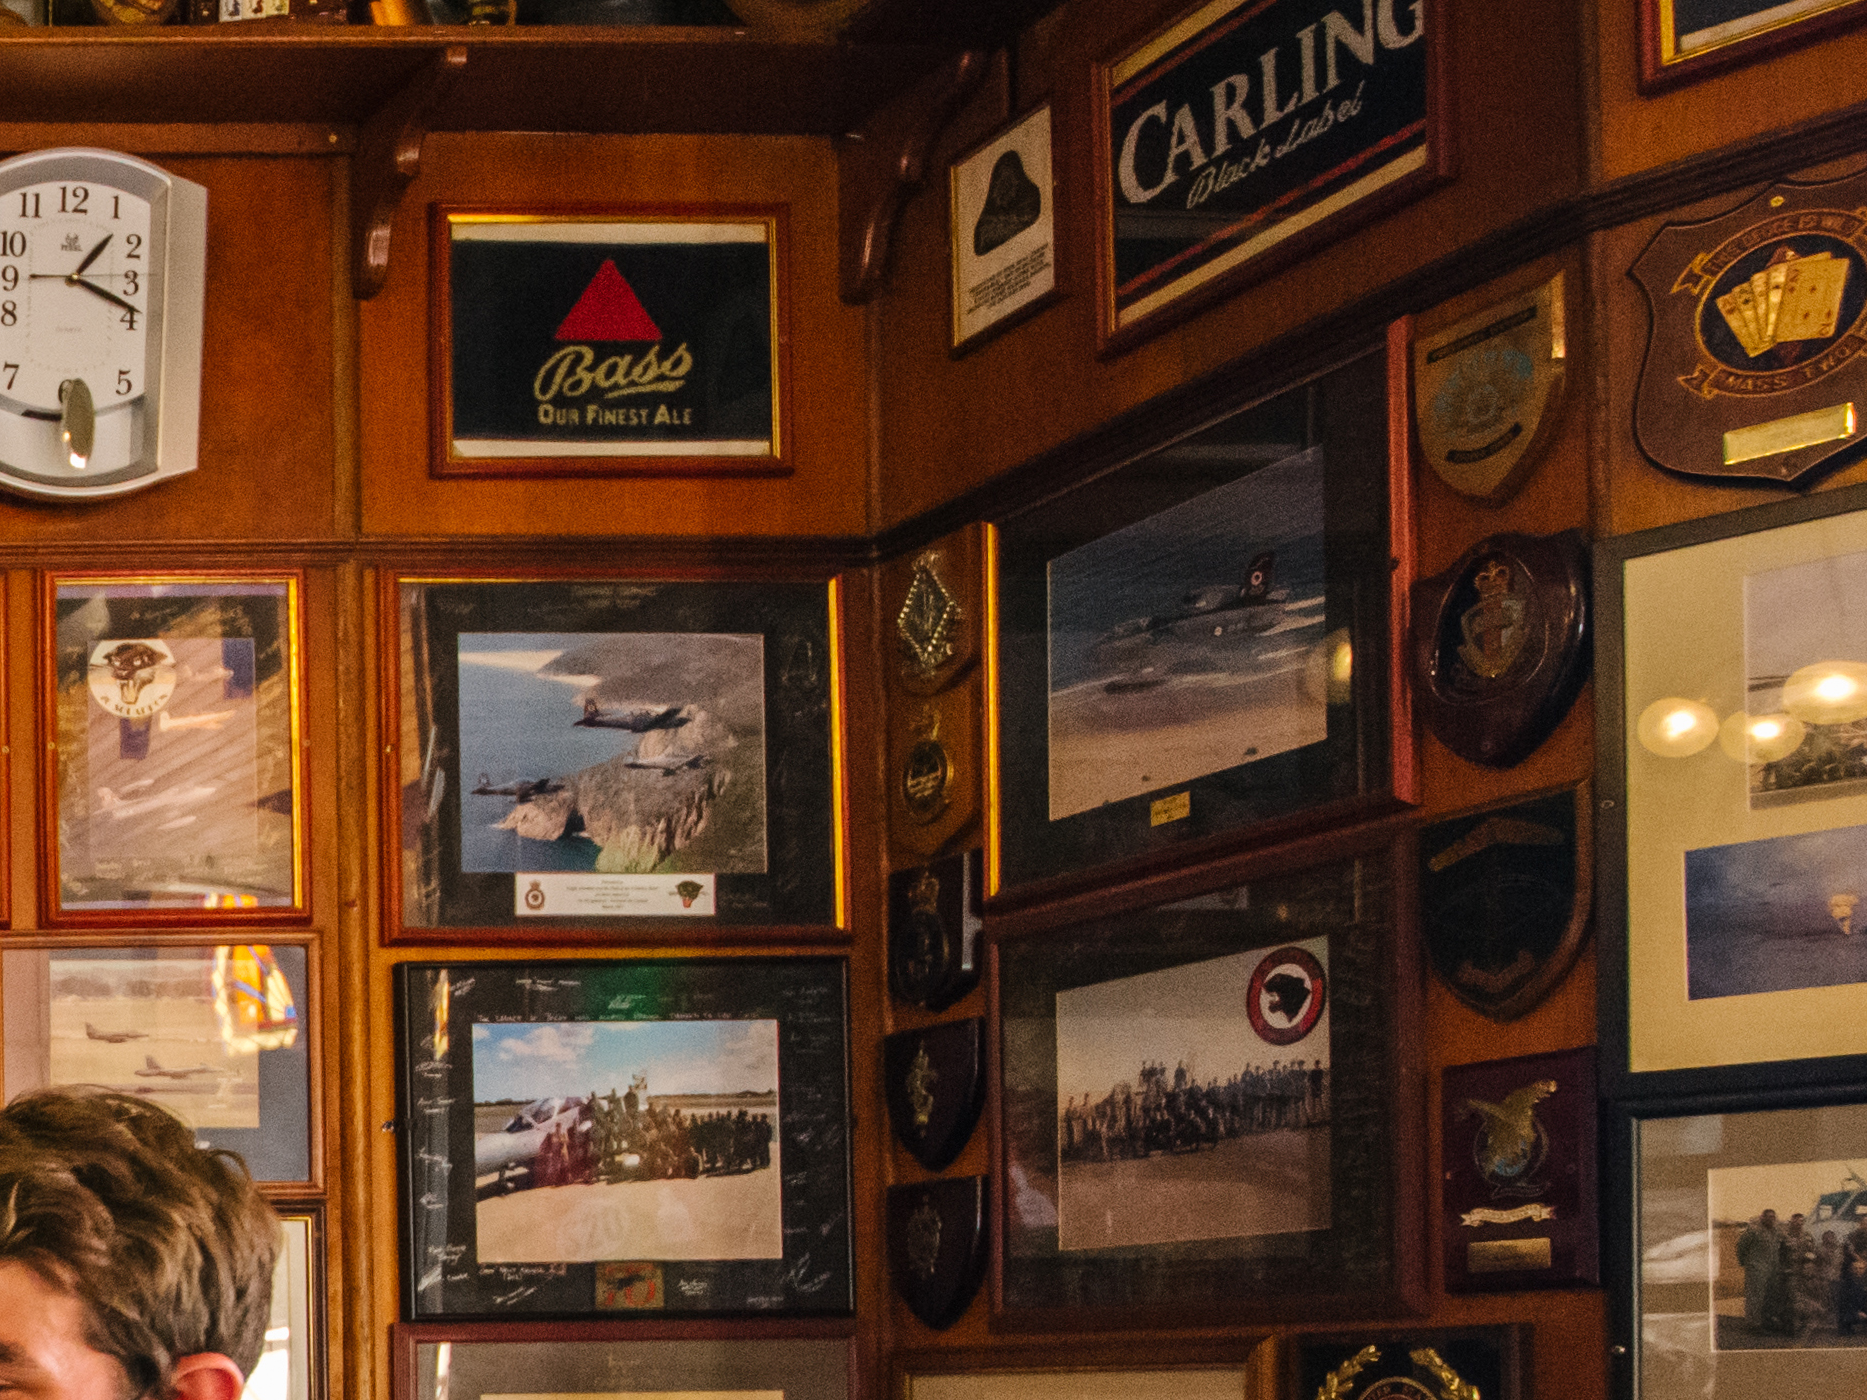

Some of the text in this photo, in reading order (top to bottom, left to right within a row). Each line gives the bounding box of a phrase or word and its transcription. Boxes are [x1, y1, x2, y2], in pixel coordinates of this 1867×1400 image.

[1118, 0, 1423, 203] CARLING
[1187, 80, 1365, 209] Black Label
[20, 193, 42, 219] 11
[58, 186, 89, 215] 12
[112, 195, 121, 219] 1
[0, 231, 26, 257] 10
[126, 234, 142, 259] 2
[2, 265, 19, 291] 9
[123, 270, 139, 296] 3
[0, 301, 17, 326] 8
[120, 306, 138, 331] 4
[3, 362, 19, 390] 7
[116, 370, 132, 395] 5
[534, 342, 693, 400] Bass
